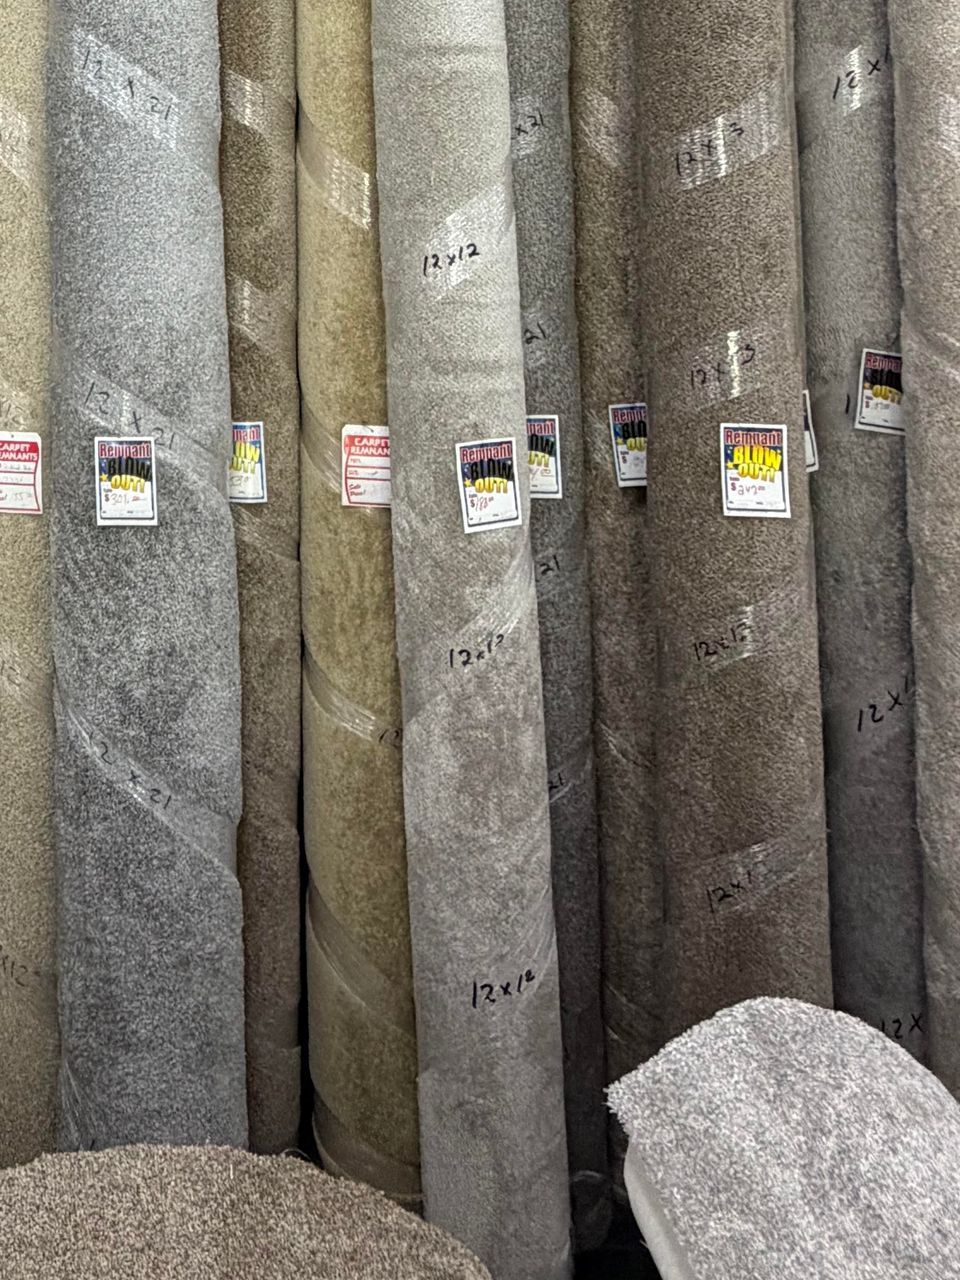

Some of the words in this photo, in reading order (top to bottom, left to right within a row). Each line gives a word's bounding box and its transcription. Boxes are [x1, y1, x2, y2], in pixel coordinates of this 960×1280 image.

[724, 429, 782, 446] Remnant
[98, 442, 152, 459] Remnant
[350, 446, 390, 456] REMNAN
[460, 443, 513, 463] Remnant
[733, 444, 782, 471] BLOW
[737, 462, 776, 483] OUT!
[110, 474, 146, 494] OUT!
